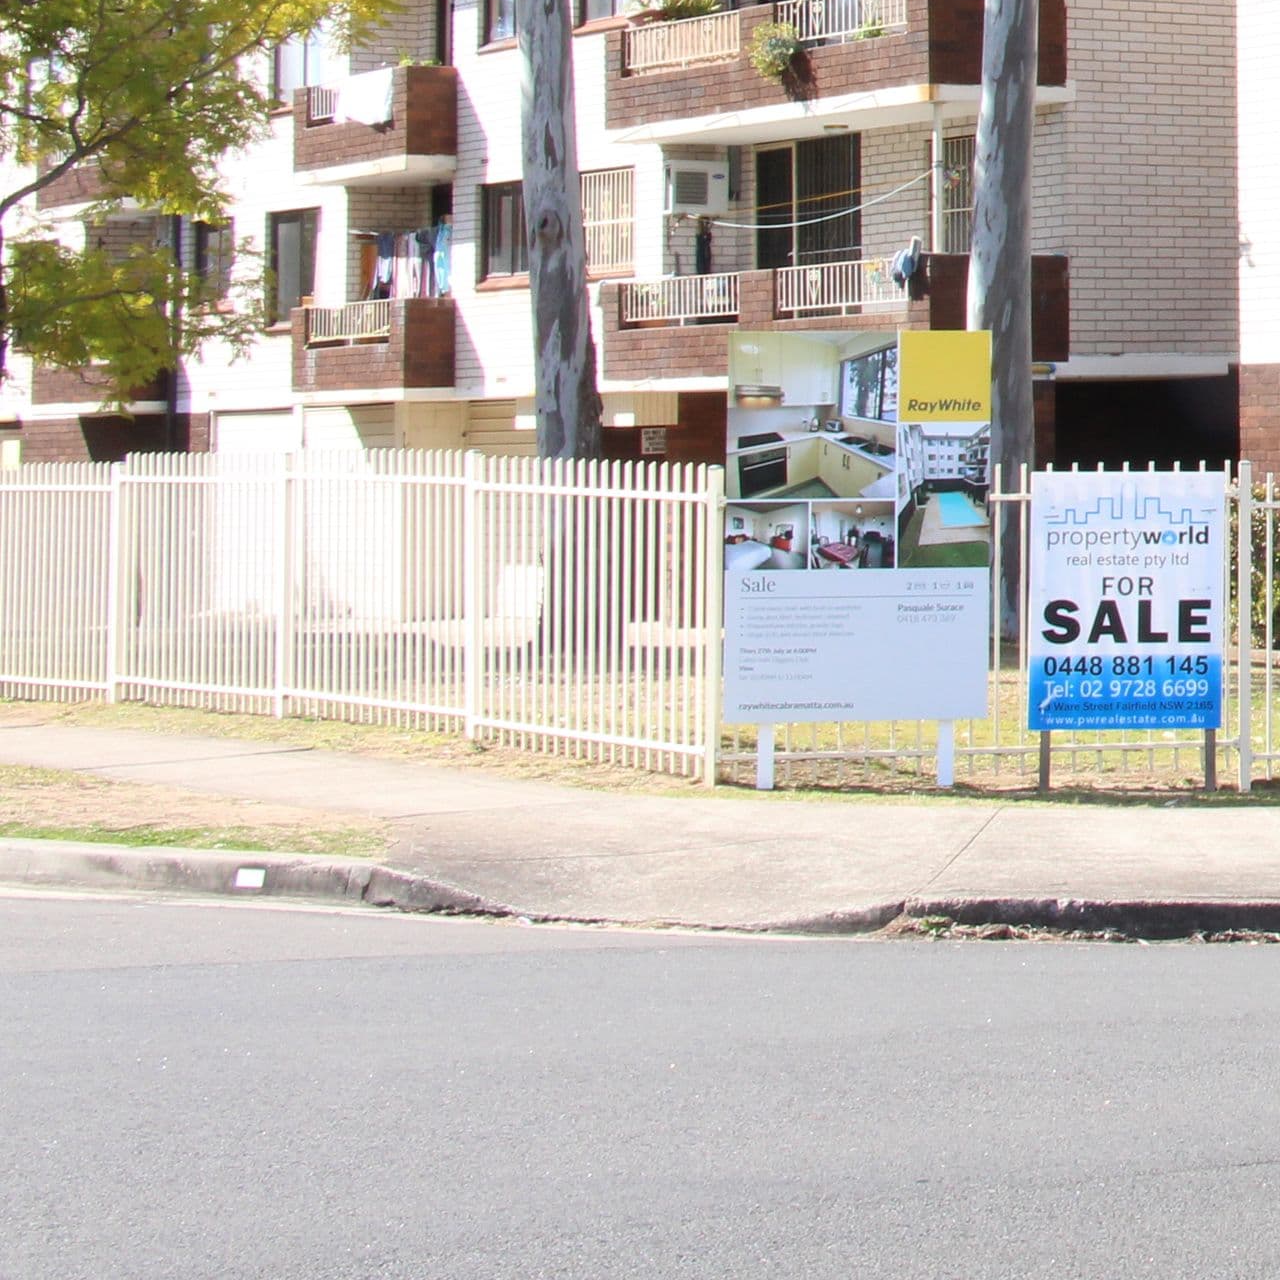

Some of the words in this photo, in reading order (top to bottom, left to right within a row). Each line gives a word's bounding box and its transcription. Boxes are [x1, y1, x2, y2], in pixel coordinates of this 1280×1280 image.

[1047, 525, 1209, 551] propertyworld
[1066, 552, 1092, 566] real
[1096, 553, 1140, 566] estate
[1144, 554, 1167, 569] pty
[1171, 552, 1190, 566] ltd
[740, 577, 776, 593] Sale
[1102, 576, 1154, 596] FOR
[1041, 599, 1211, 644] SALE
[1043, 655, 1103, 676] 0448
[1112, 655, 1153, 676] 881
[1166, 655, 1209, 675] 145
[1043, 680, 1074, 698] Tel:
[1080, 680, 1103, 698] 02
[1110, 679, 1156, 697] 9728
[1162, 679, 1209, 697] 6699
[738, 701, 855, 712] raywhitecabramatta.com.au
[1054, 702, 1081, 711] Ware
[1083, 702, 1113, 711] Street
[1116, 701, 1157, 711] Fairfield
[1159, 701, 1185, 710] NSW
[1187, 701, 1214, 711] 2165
